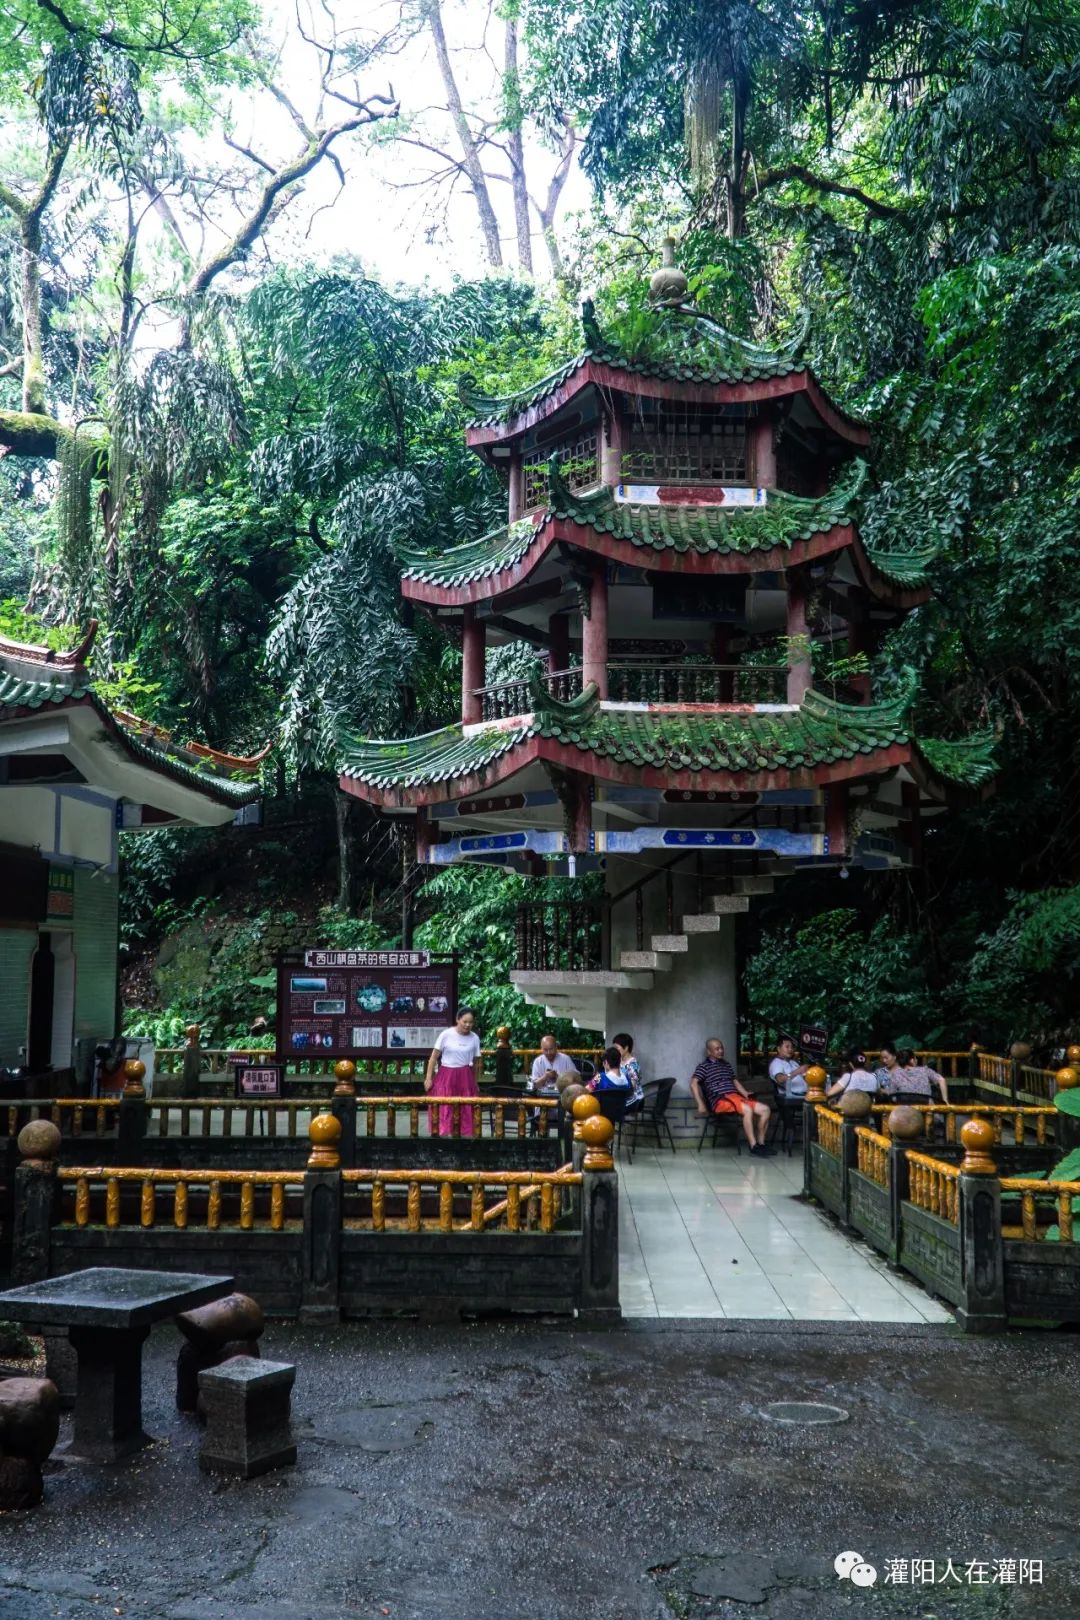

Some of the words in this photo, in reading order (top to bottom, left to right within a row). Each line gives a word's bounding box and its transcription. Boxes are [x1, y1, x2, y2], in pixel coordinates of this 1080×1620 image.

[316, 953, 419, 965] 西山棋盘茶的传奇故事
